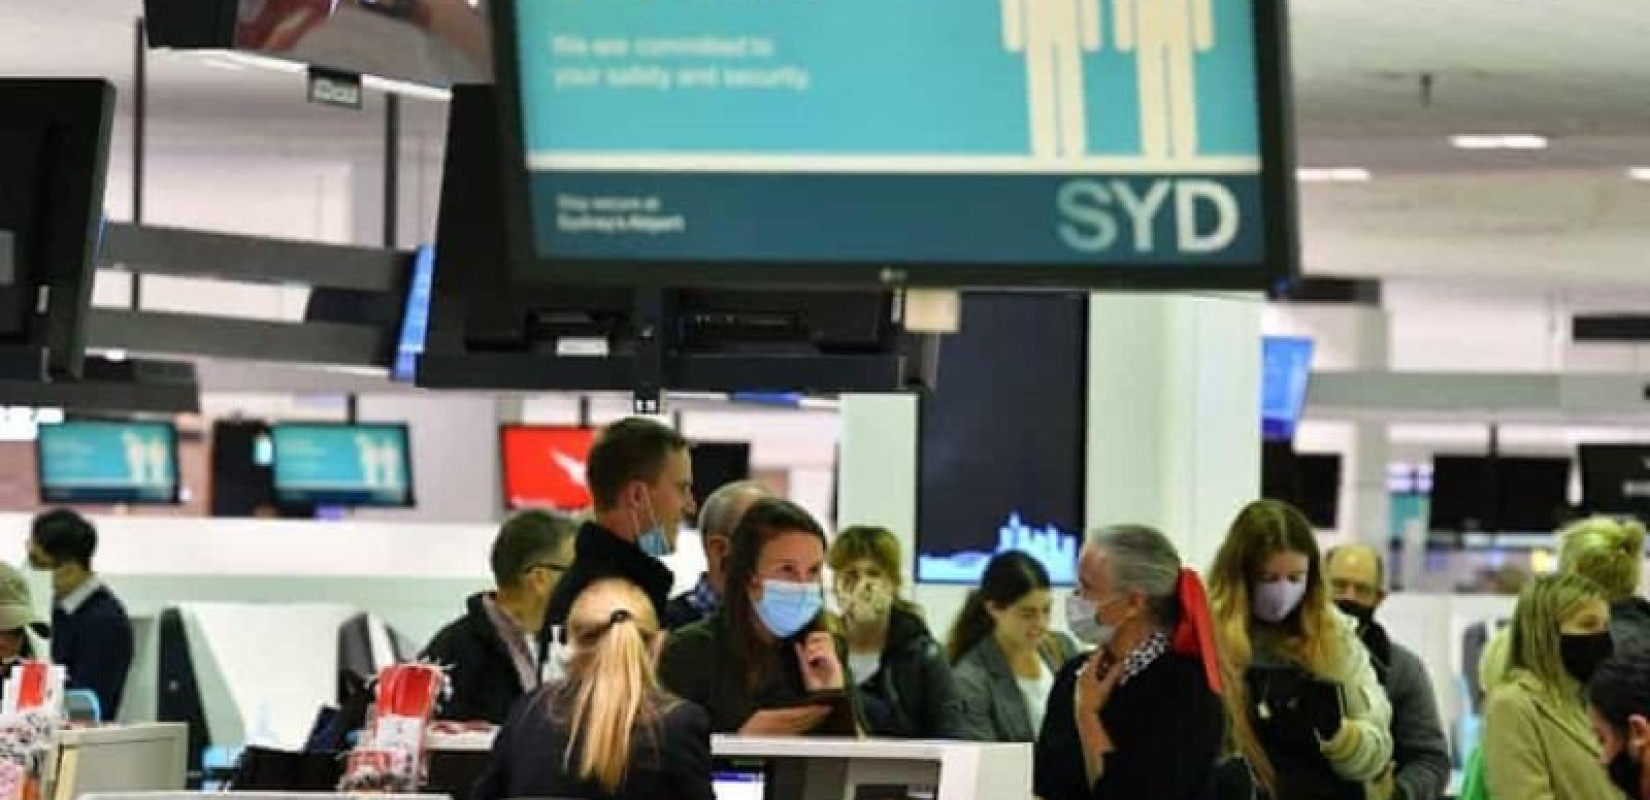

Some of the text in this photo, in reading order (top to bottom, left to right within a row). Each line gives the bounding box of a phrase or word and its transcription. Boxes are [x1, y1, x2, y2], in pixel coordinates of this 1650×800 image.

[634, 36, 747, 57] committed
[554, 69, 600, 91] your
[604, 64, 671, 91] safety
[676, 64, 720, 87] and
[1057, 179, 1240, 252] SYD
